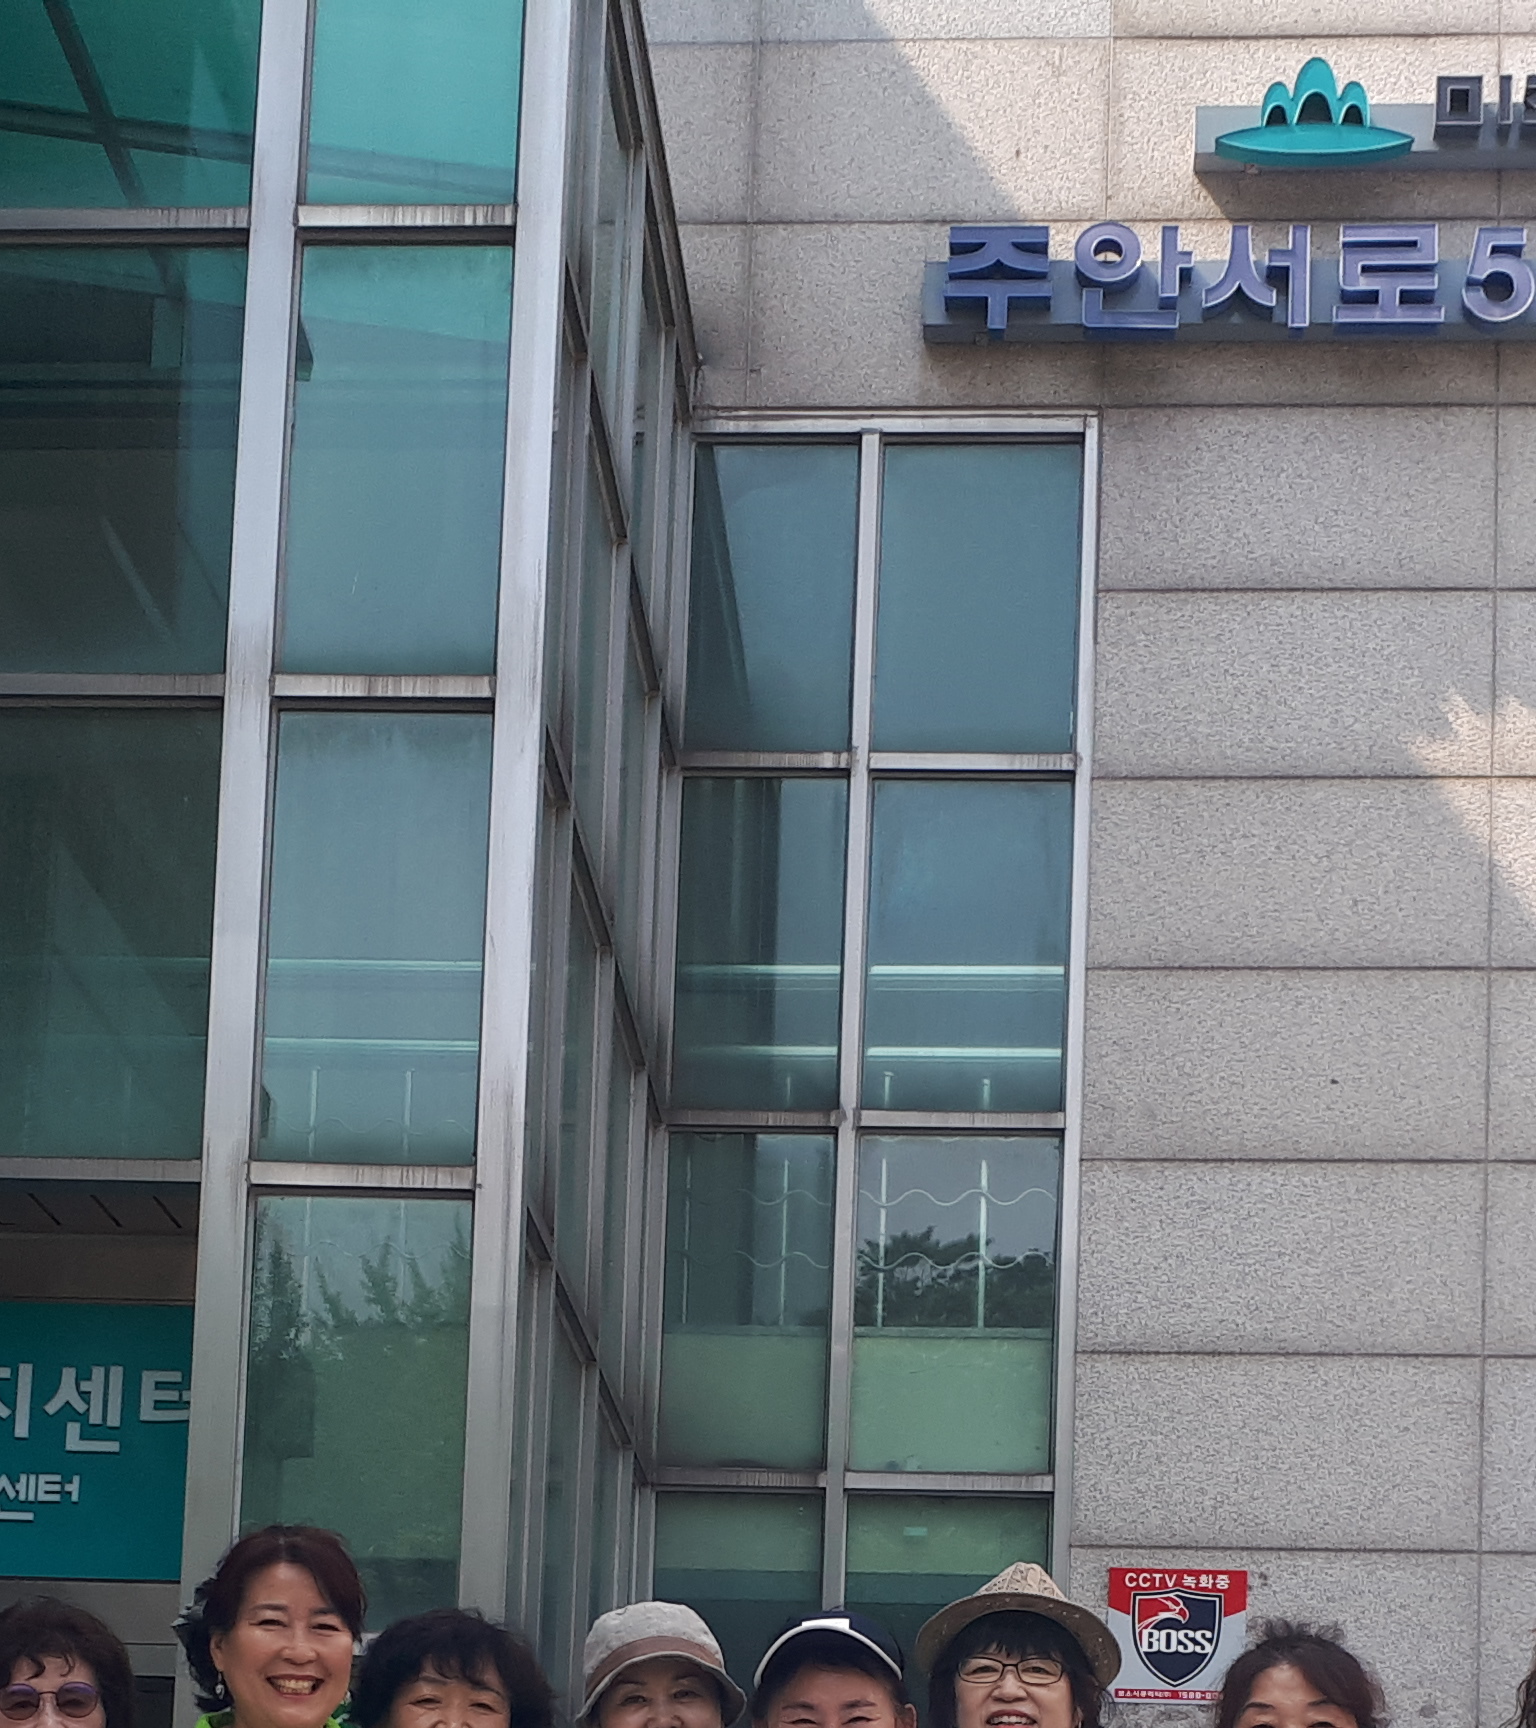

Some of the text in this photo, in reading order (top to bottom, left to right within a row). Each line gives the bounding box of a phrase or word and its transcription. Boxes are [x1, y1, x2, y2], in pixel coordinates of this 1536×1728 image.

[1124, 1572, 1231, 1590] CCTV 녹화중
[1140, 1628, 1213, 1654] BOSS
